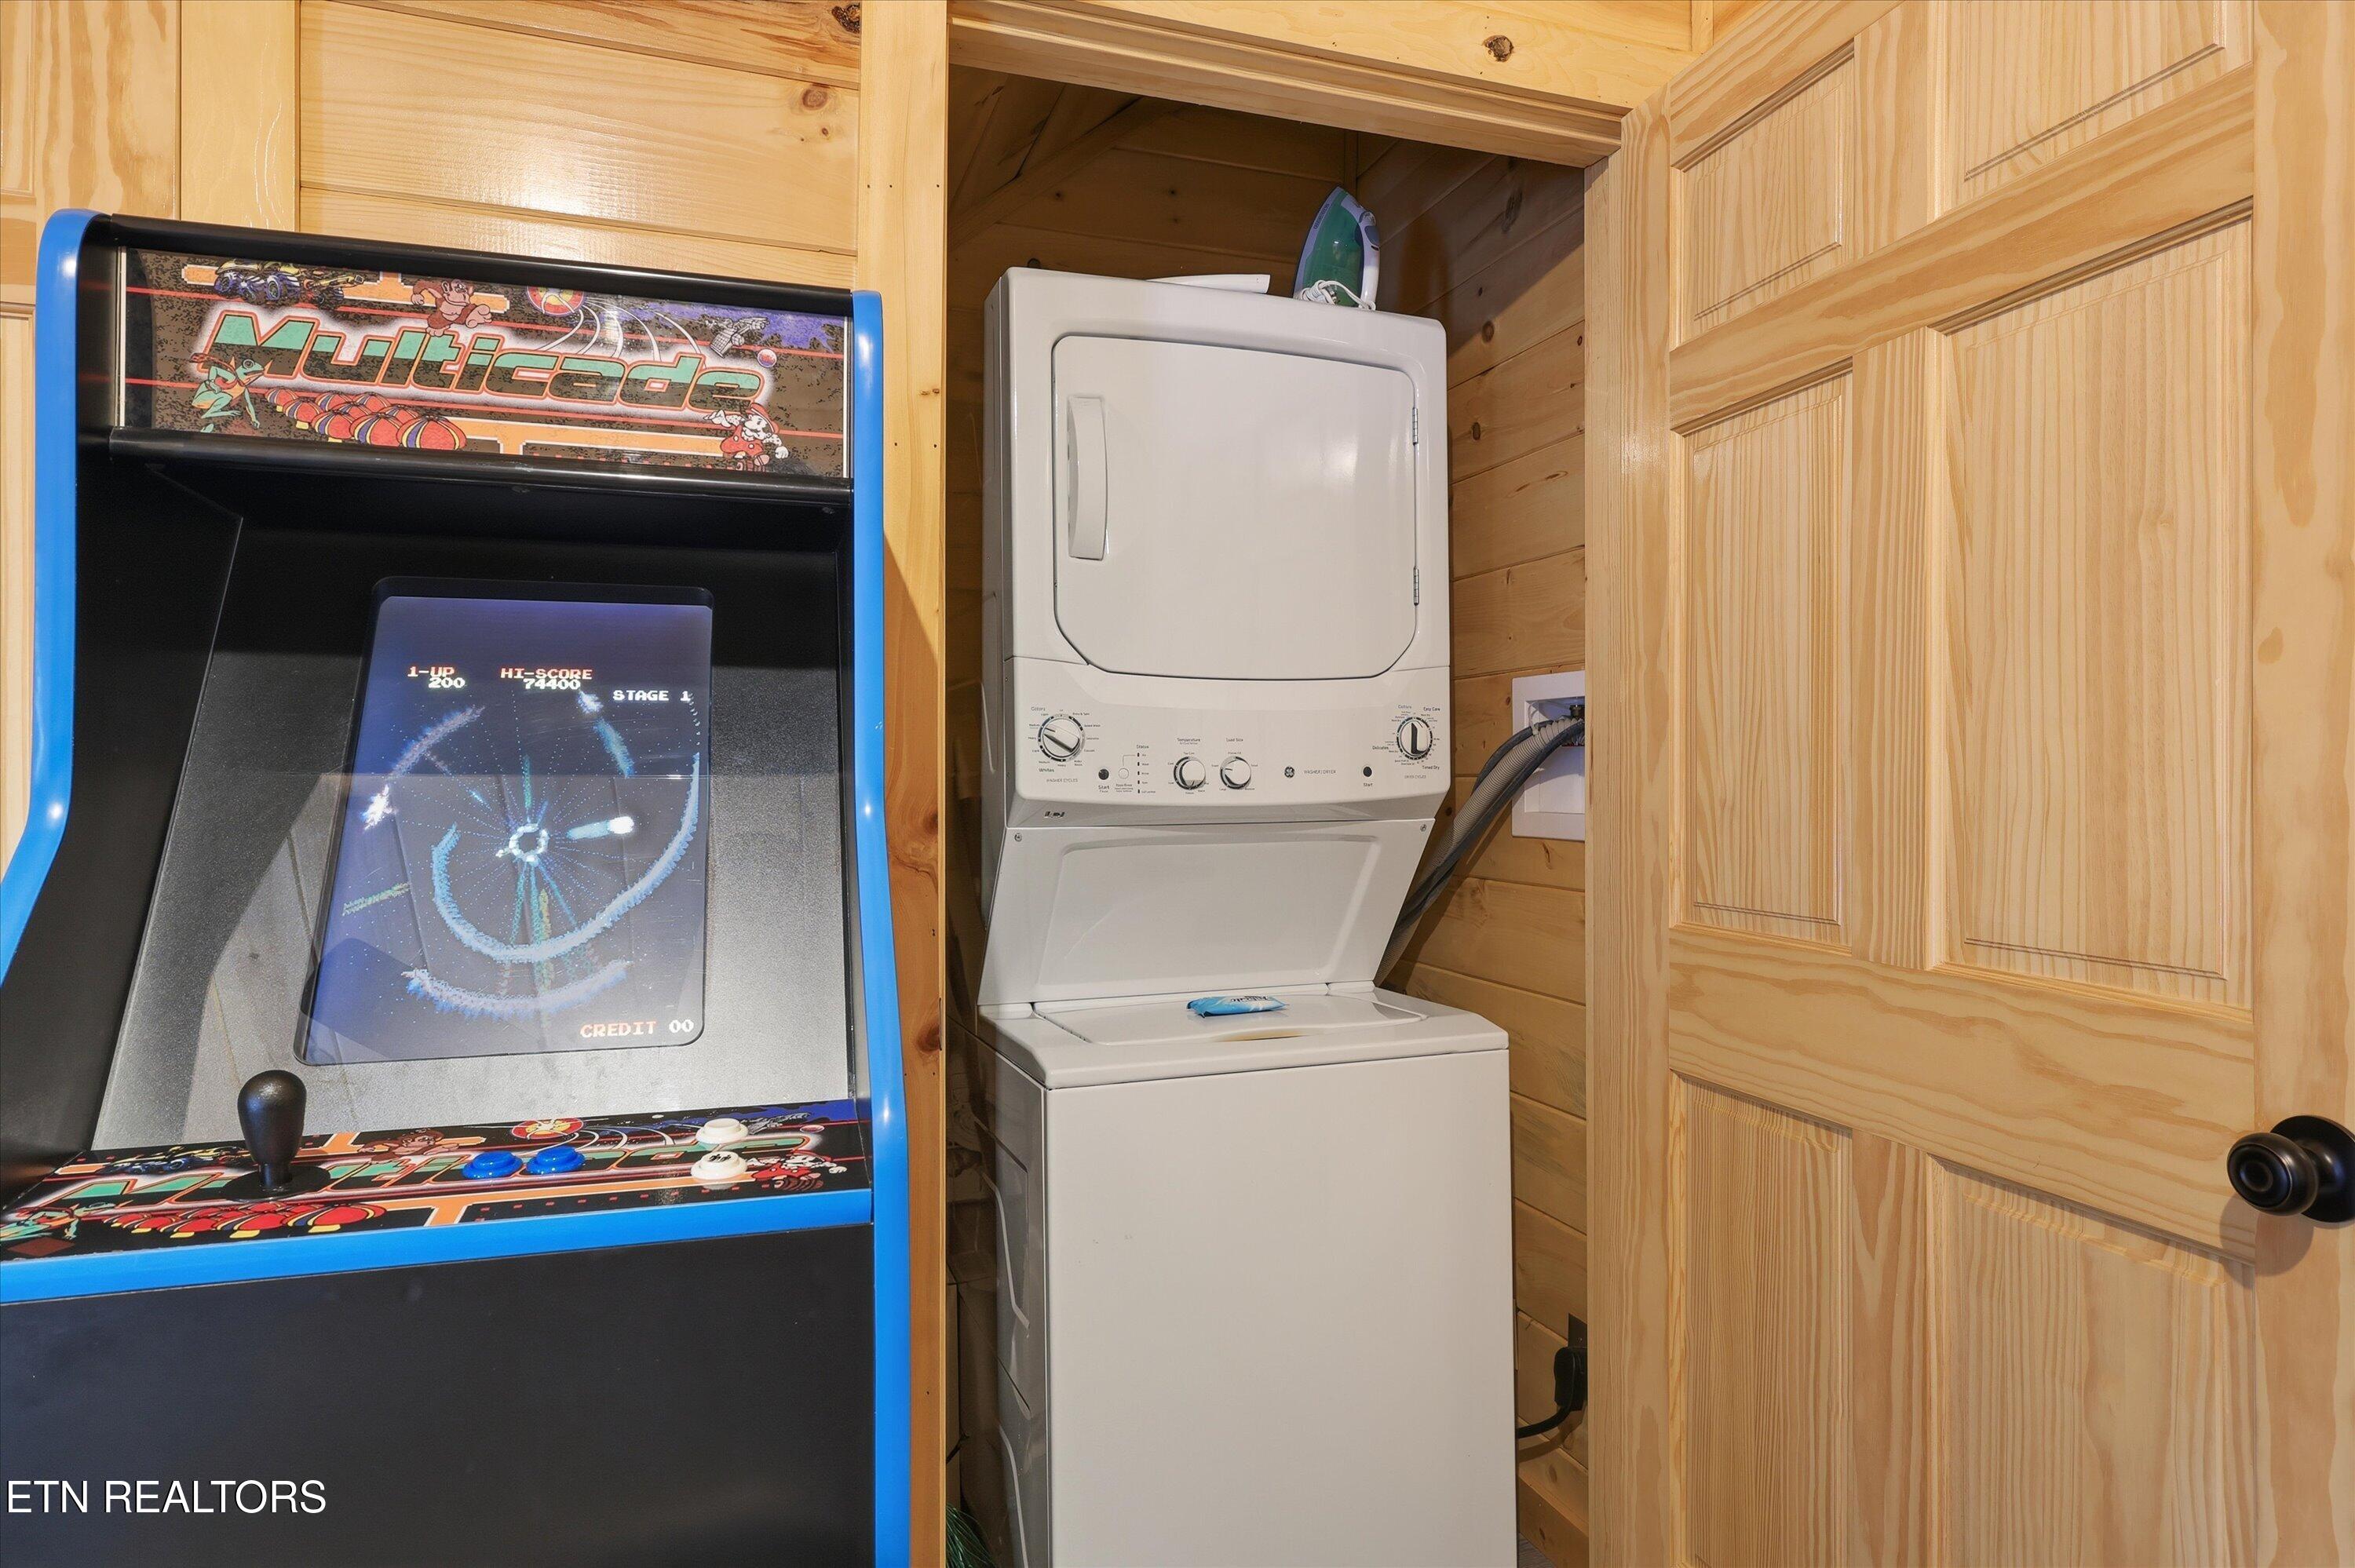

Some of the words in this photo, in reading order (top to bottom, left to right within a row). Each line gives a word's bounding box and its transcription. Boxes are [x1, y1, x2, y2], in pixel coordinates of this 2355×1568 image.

[195, 308, 769, 413] Multicade
[407, 666, 455, 678] 1-UP
[499, 667, 593, 680] HI-SCORE
[428, 677, 466, 689] 200
[523, 679, 581, 690] 74400
[612, 690, 670, 702] STAGE
[680, 690, 691, 702] 1
[580, 1021, 657, 1038] CREDIT
[668, 1019, 695, 1034] 00
